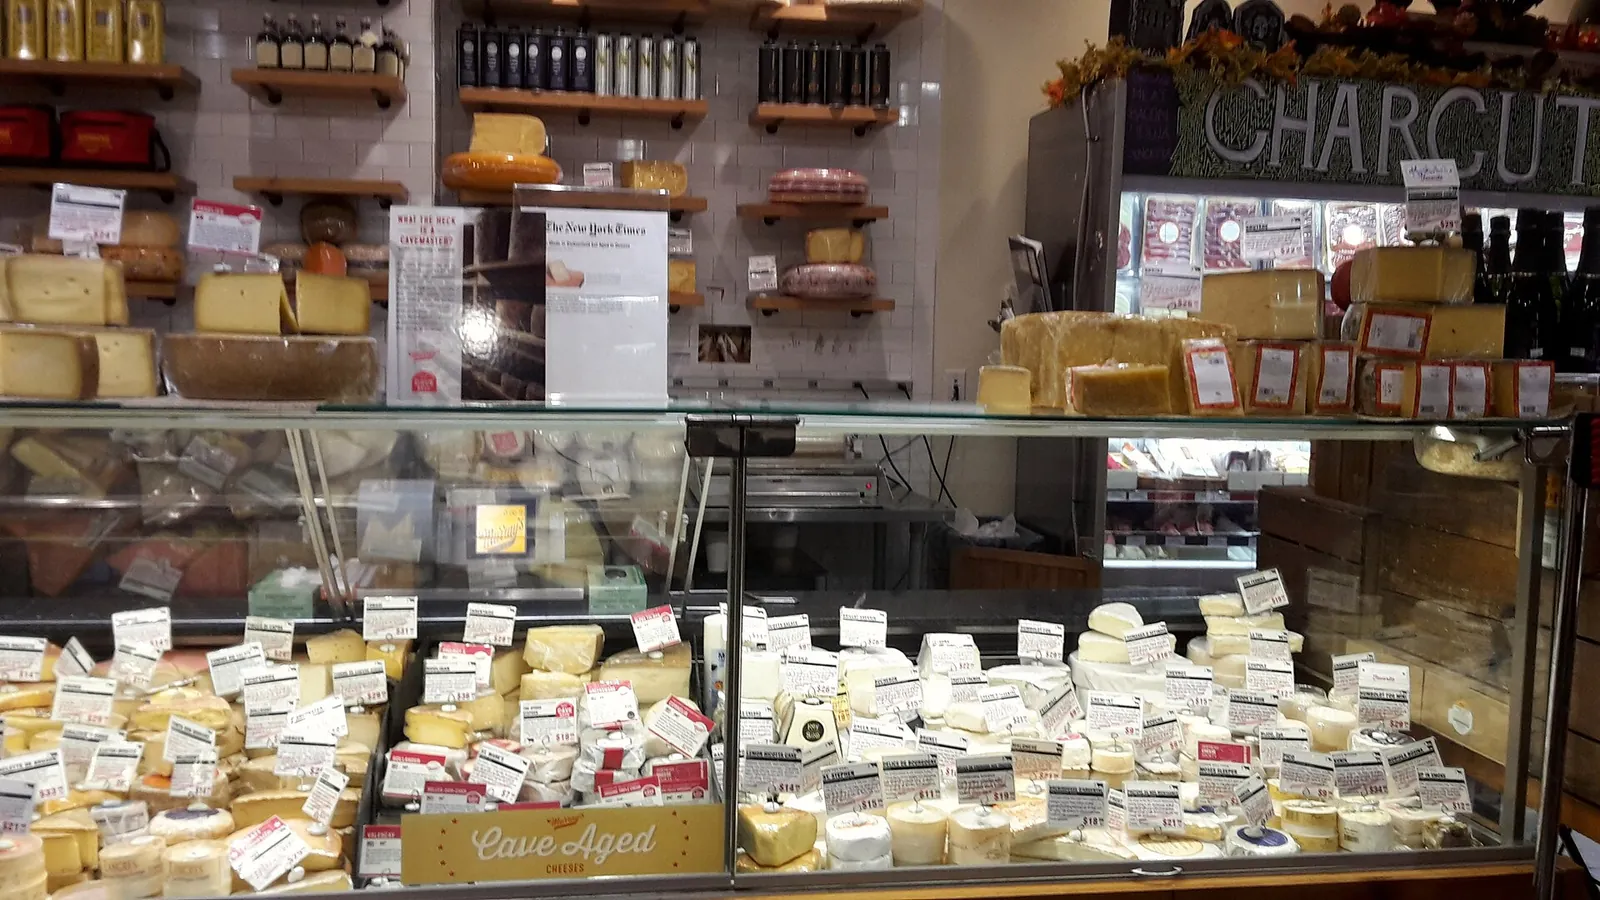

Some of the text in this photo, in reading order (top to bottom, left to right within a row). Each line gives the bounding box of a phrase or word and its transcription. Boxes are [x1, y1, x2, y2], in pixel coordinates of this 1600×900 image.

[397, 215, 456, 224] WHAT THE HECK
[420, 226, 435, 234] IS A
[546, 220, 647, 237] The New York Times
[471, 823, 657, 865] Cave Aged
[546, 863, 585, 875] CHEESES
